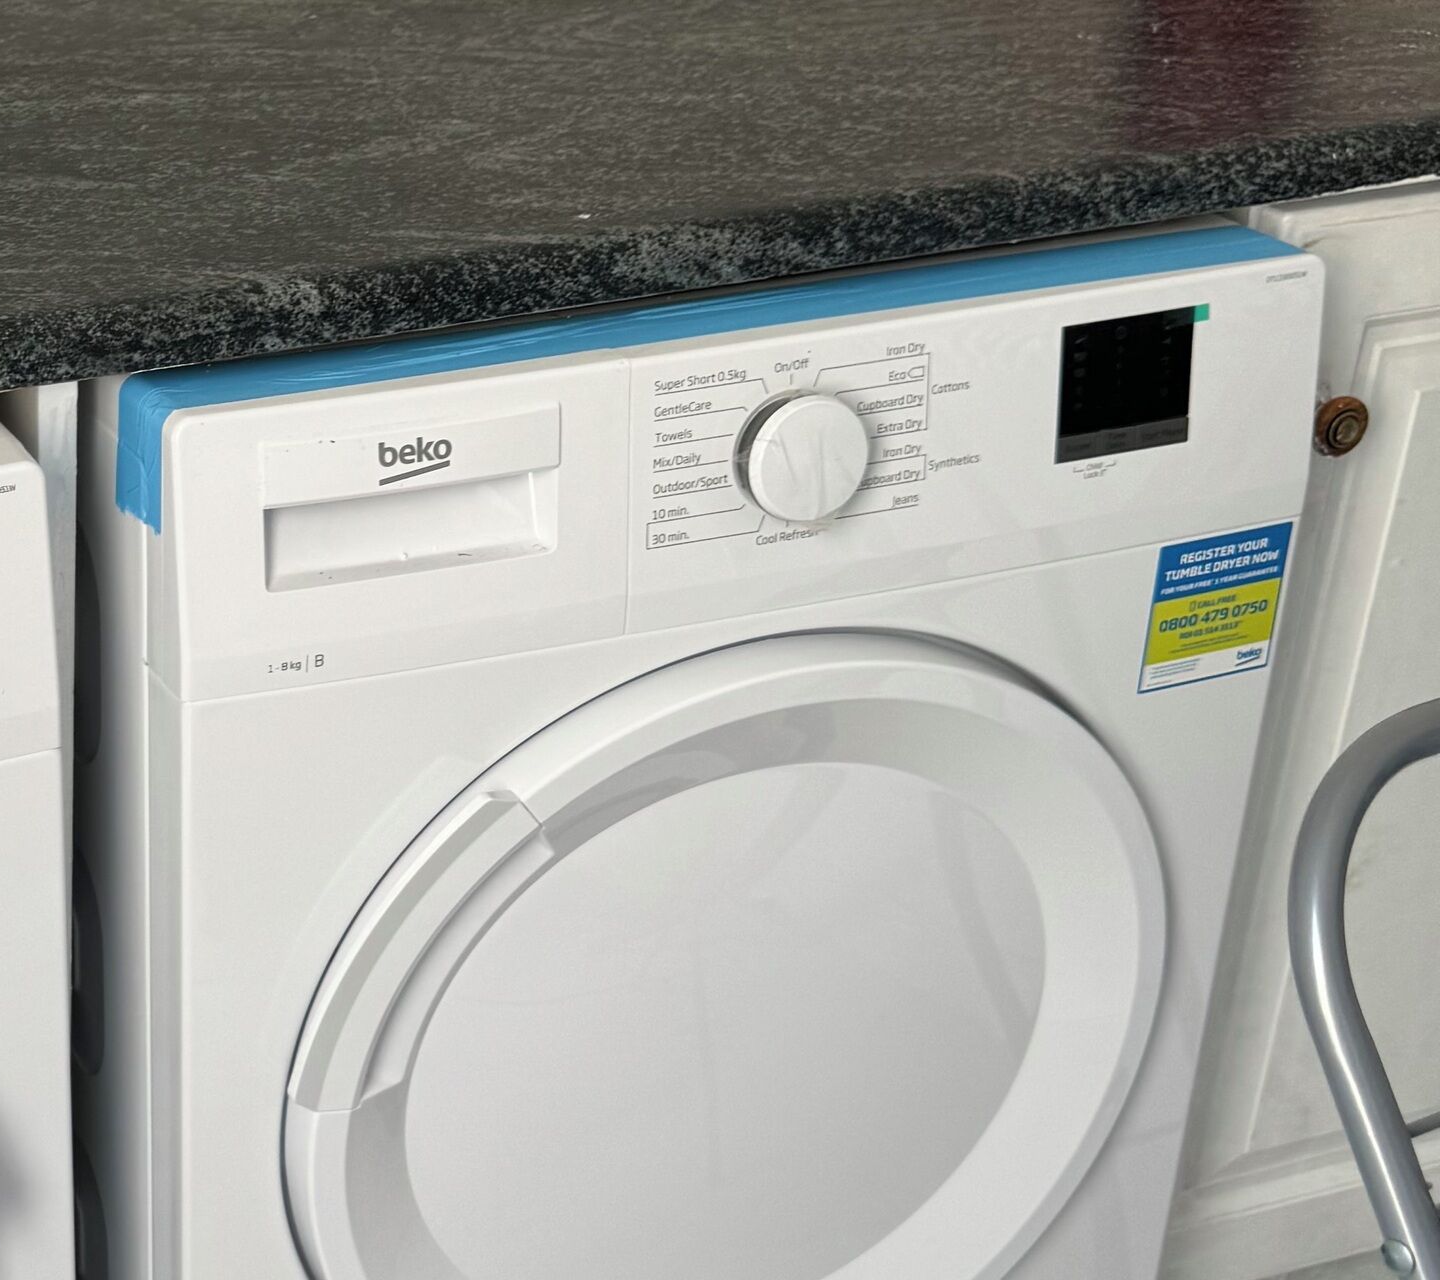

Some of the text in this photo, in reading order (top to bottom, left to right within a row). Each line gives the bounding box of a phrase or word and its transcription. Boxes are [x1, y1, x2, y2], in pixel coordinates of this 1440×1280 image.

[886, 343, 926, 356] Iron Dry
[774, 358, 810, 374] On/Off
[654, 370, 747, 392] Super Short 0.5kg
[889, 371, 906, 382] Eco
[931, 381, 970, 395] Cottons
[654, 400, 712, 418] GentleCare
[857, 394, 924, 413] Cupboard Dry
[877, 419, 923, 434] Extra Dry
[656, 429, 693, 443] Towels
[378, 437, 452, 468] beko
[883, 445, 922, 458] Iron Dry
[653, 453, 702, 470] Mix/Daily
[928, 454, 981, 472] Synthetics
[903, 470, 921, 481] Dry
[653, 474, 729, 495] Outdoor/Sport
[892, 493, 920, 508] Jeans
[652, 505, 690, 521] 10 min.
[651, 530, 690, 545] 30 min.
[756, 534, 778, 546] Cool
[1180, 537, 1269, 565] REGISTER YOUR
[1164, 550, 1280, 582] TUMBLE DRYER NOW
[1159, 599, 1269, 633] 0800 479 0750
[315, 654, 325, 668] B
[1236, 648, 1263, 660] beko
